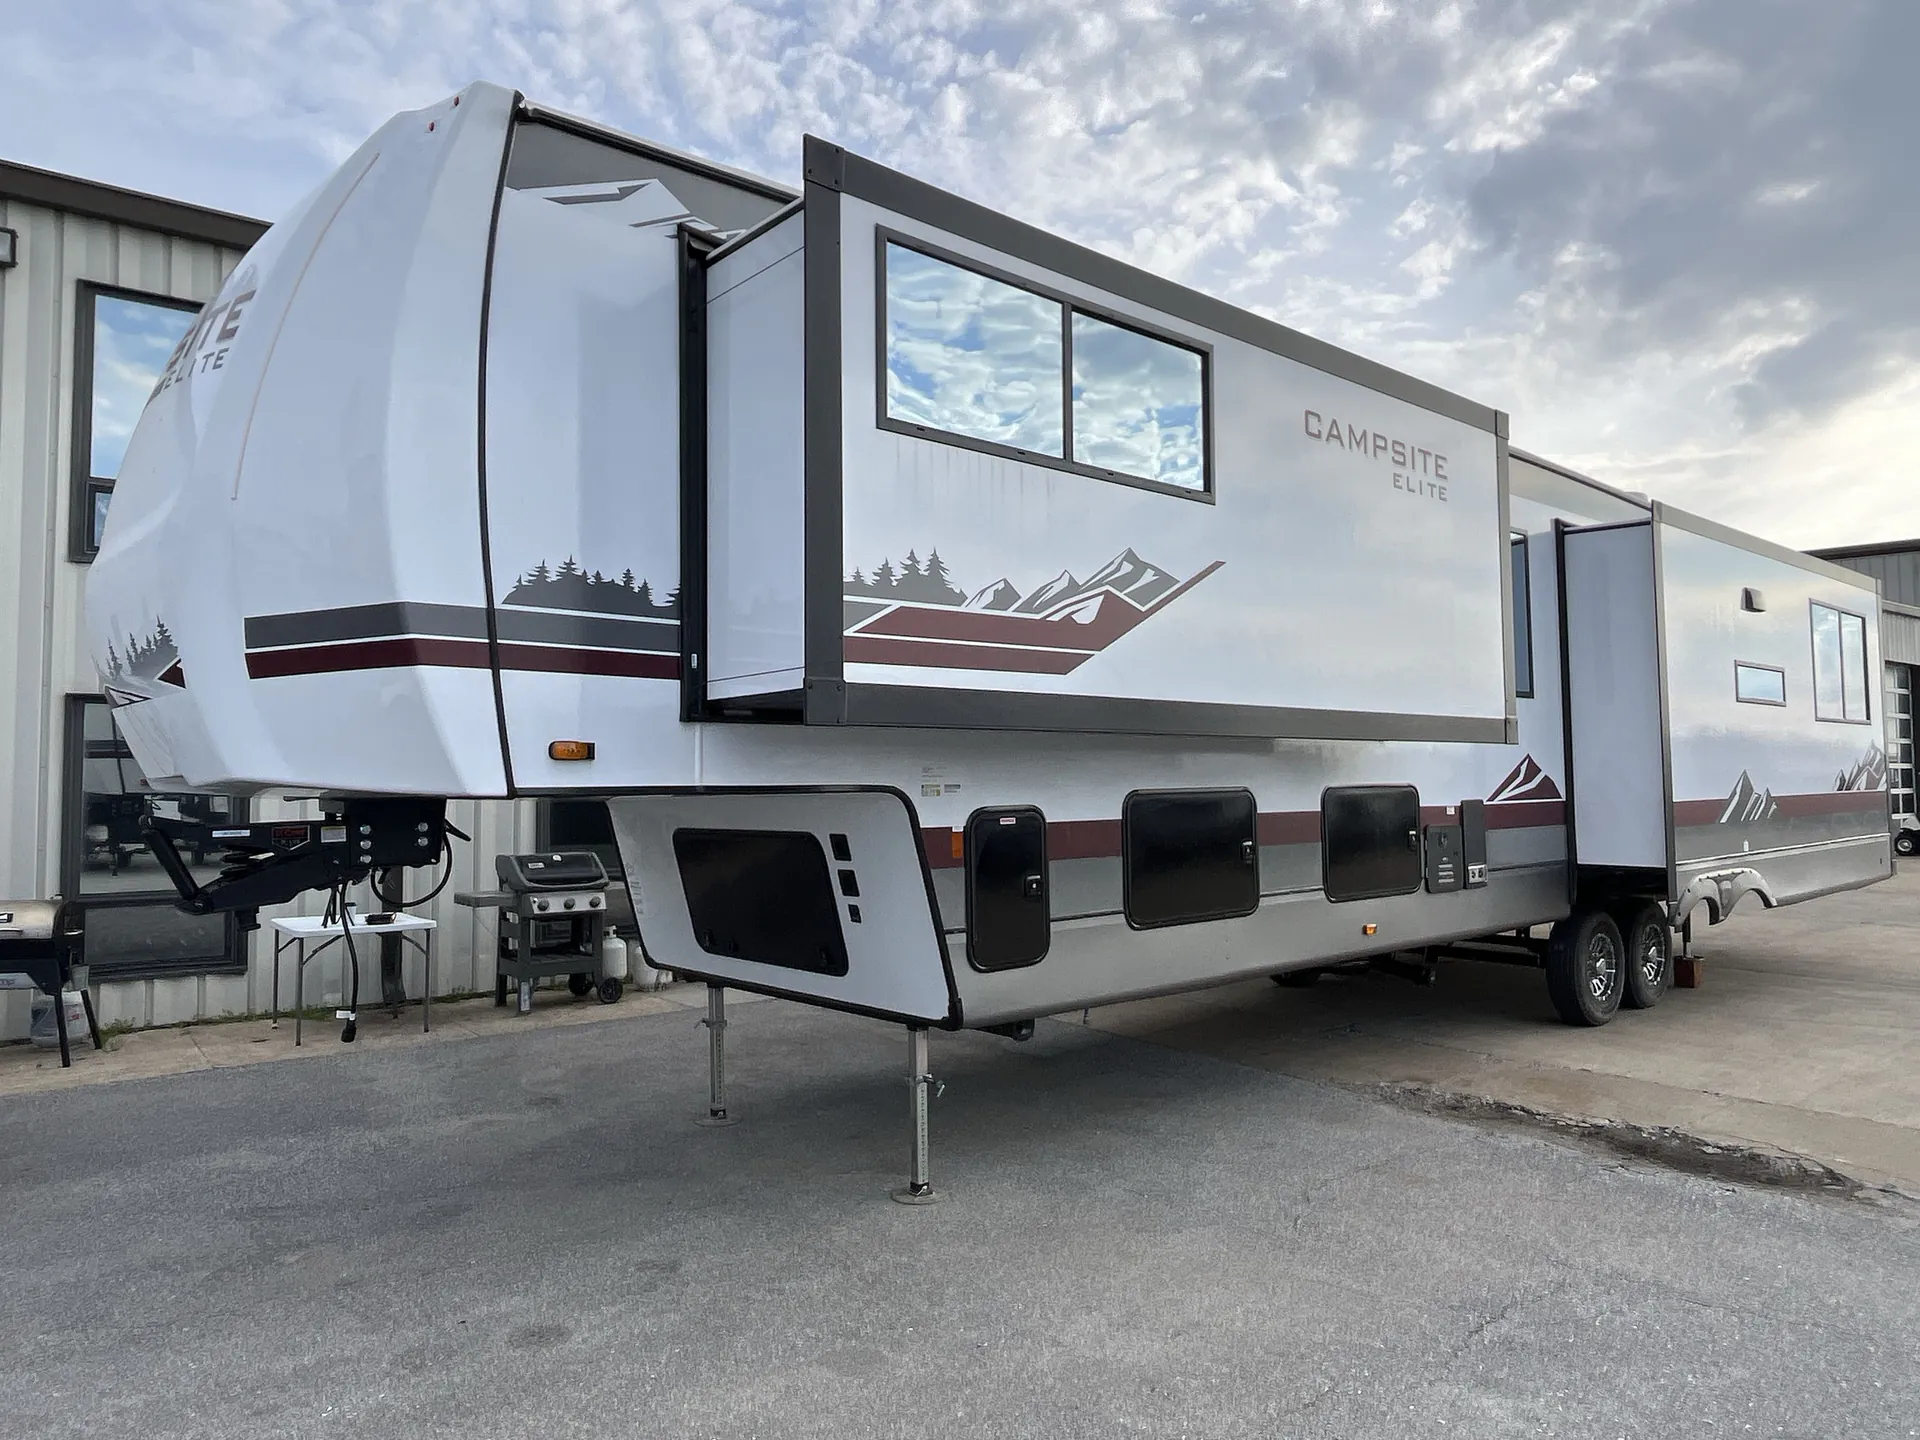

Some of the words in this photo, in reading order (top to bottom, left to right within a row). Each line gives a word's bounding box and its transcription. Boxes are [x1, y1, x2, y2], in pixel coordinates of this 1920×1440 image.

[163, 347, 230, 391] ELITE
[1304, 409, 1449, 481] CAMPSITE
[1393, 472, 1448, 501] ELITE
